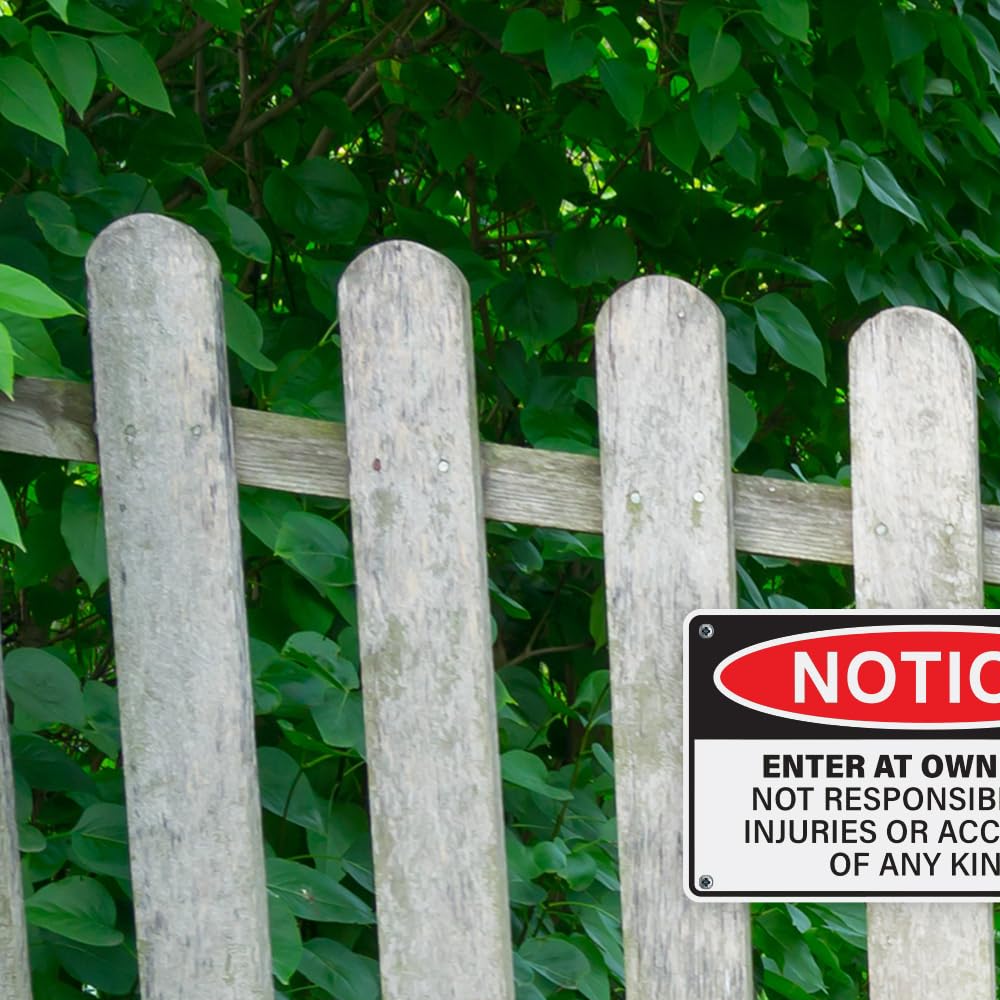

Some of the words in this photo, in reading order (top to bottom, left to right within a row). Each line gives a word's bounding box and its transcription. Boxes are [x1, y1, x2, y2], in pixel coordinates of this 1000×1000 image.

[763, 755, 865, 778] ENTER
[874, 755, 912, 778] AT
[922, 755, 996, 778] OWN
[753, 787, 814, 811] NOT
[746, 820, 876, 843] INJURIES
[887, 820, 927, 843] OR
[830, 852, 869, 876] OF
[880, 853, 941, 876] ANY
